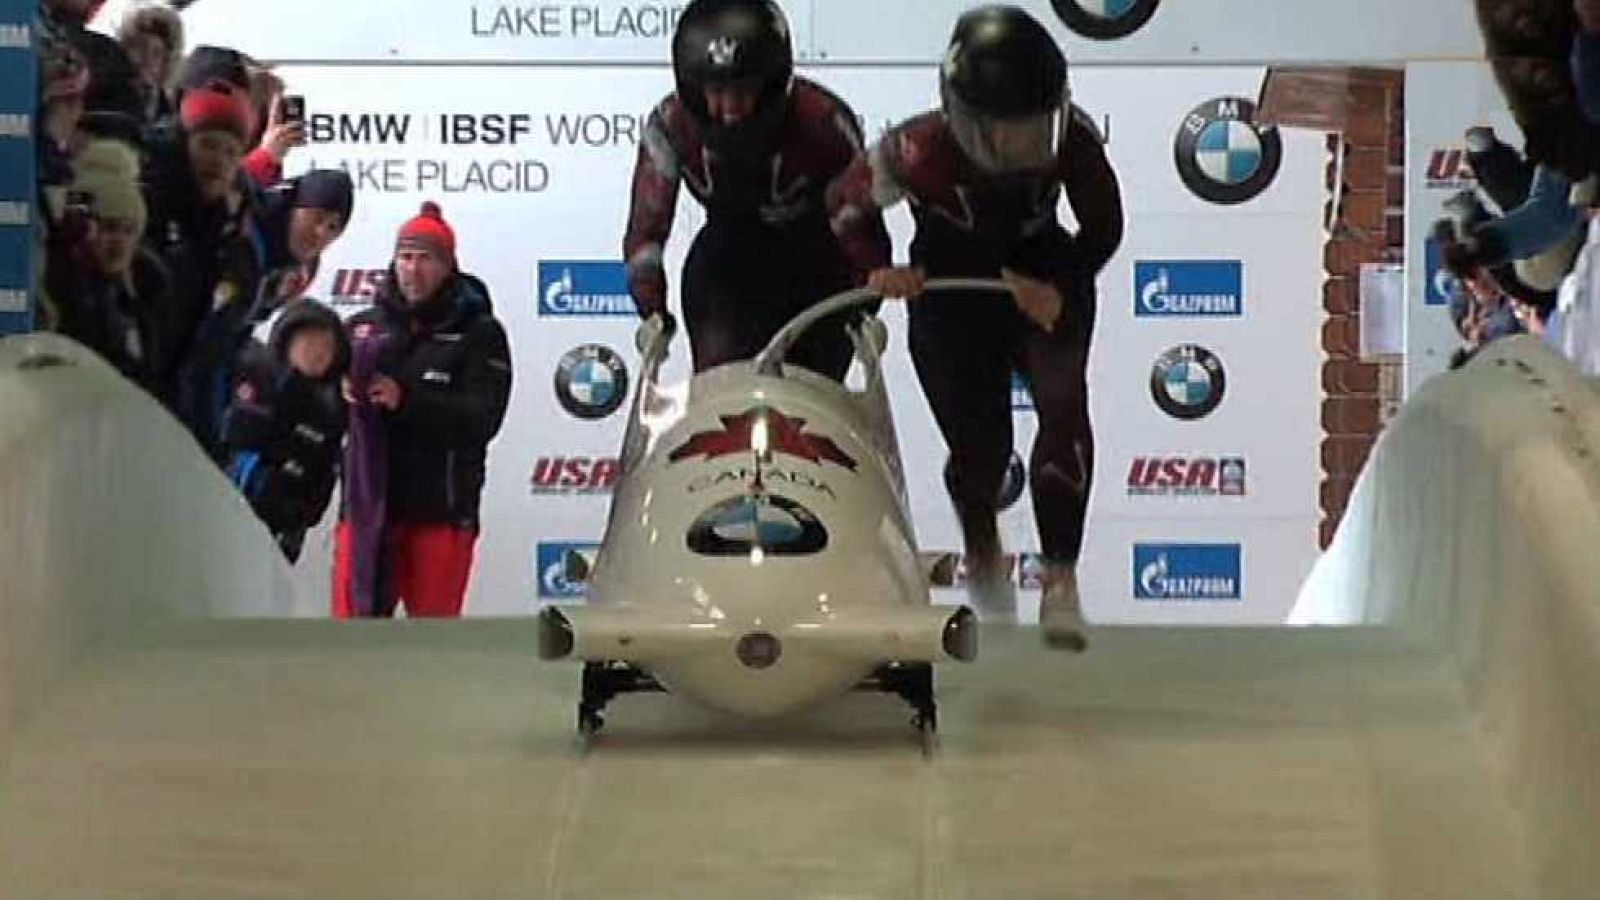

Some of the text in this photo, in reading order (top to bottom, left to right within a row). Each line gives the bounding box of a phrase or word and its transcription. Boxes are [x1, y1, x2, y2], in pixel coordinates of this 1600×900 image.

[471, 7, 561, 37] LAKE
[310, 114, 411, 145] BMW
[440, 114, 532, 145] IBSF
[311, 159, 550, 193] KE PLACID
[531, 458, 622, 487] USA
[1127, 458, 1217, 486] USA
